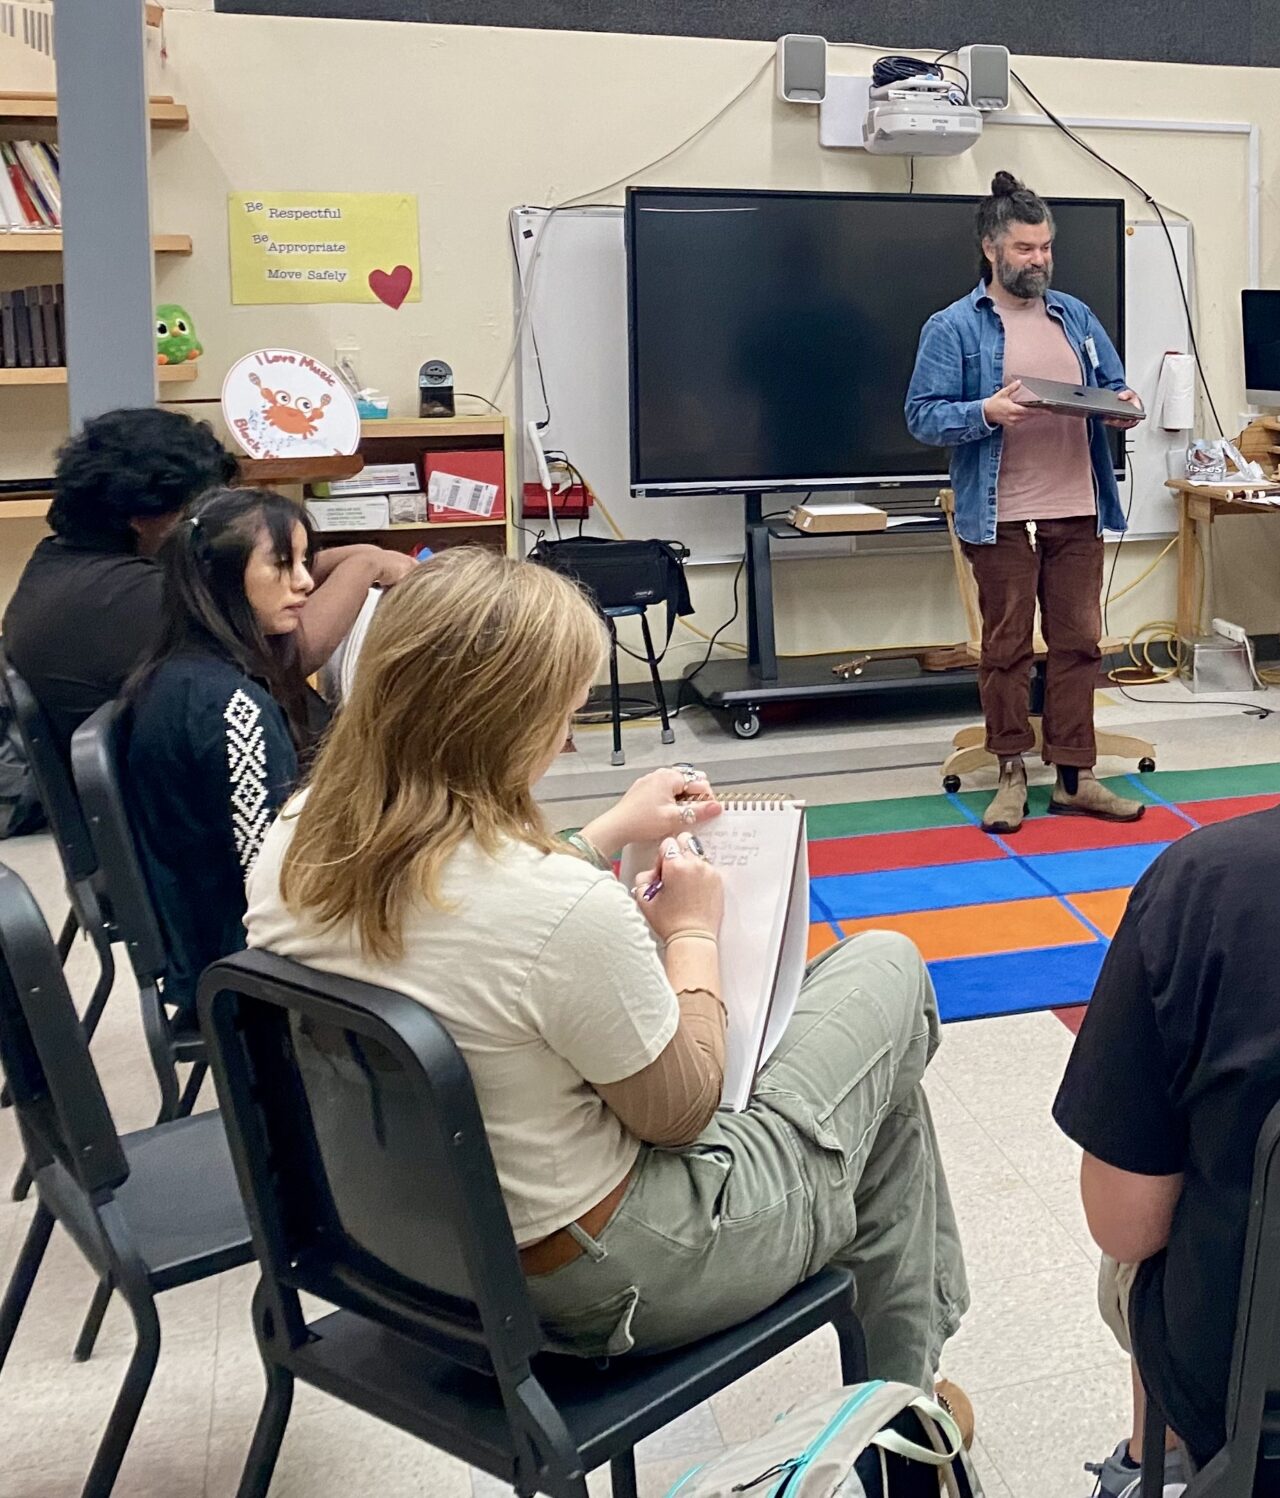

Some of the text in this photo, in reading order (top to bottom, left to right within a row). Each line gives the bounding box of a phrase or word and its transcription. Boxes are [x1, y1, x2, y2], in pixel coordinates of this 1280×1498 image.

[245, 201, 341, 220] Be Respectful
[252, 233, 346, 254] Be Appropriate
[267, 269, 347, 282] Move Safely
[255, 350, 336, 387] I Love Music
